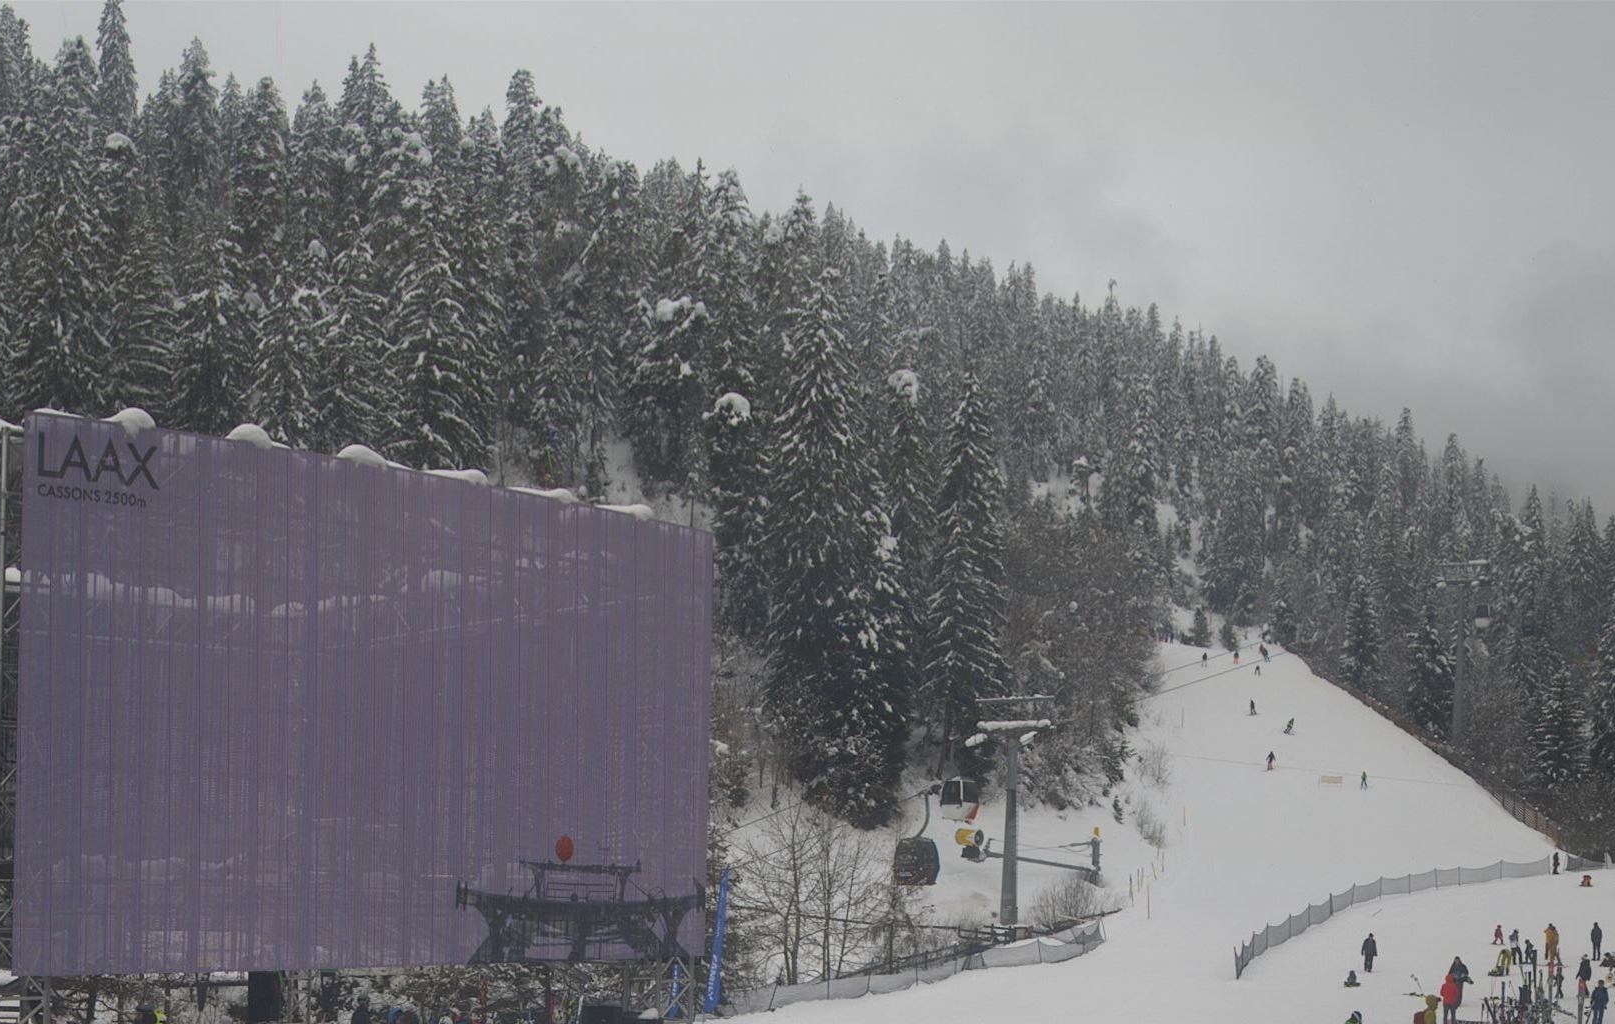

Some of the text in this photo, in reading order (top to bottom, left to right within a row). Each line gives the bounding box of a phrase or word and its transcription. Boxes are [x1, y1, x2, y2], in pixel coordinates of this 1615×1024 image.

[38, 432, 160, 490] LAAX
[38, 484, 147, 508] CASSONS 2500m
